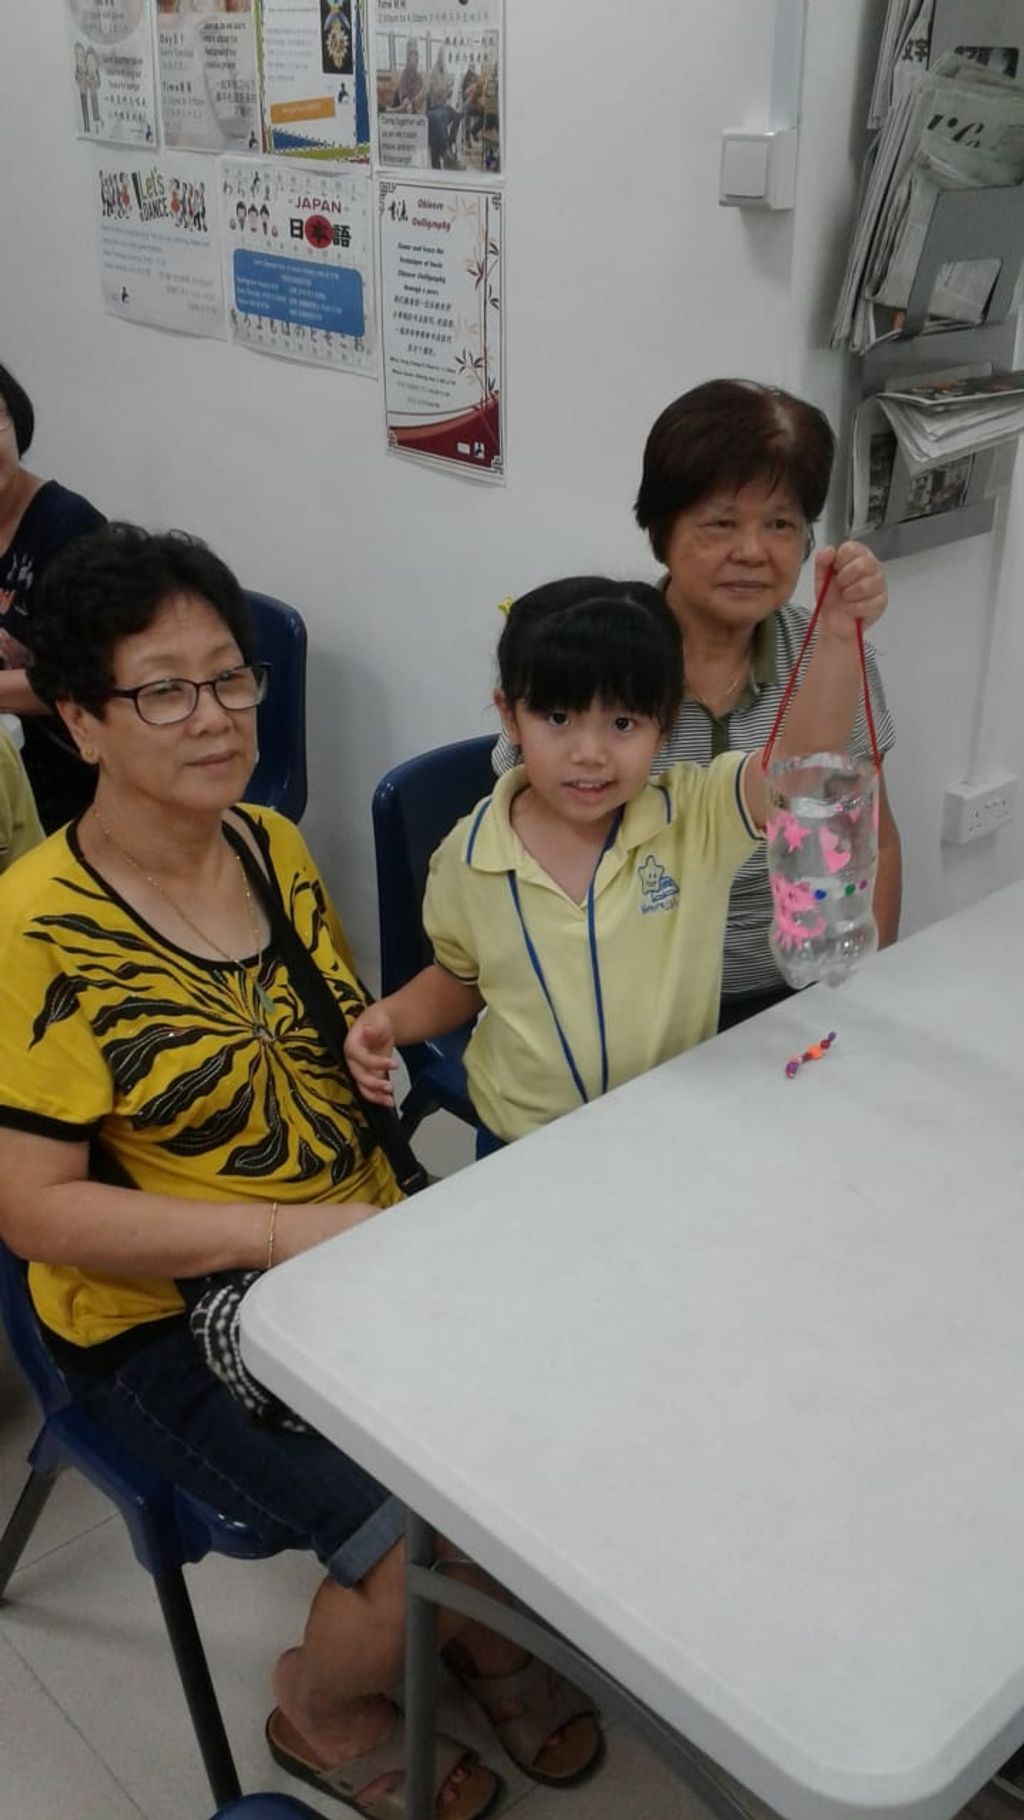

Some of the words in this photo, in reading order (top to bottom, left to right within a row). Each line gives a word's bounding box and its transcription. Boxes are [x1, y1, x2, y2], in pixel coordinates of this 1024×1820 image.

[142, 197, 169, 221] DANCE
[295, 196, 341, 214] JAPAN
[289, 217, 352, 248] 日本語
